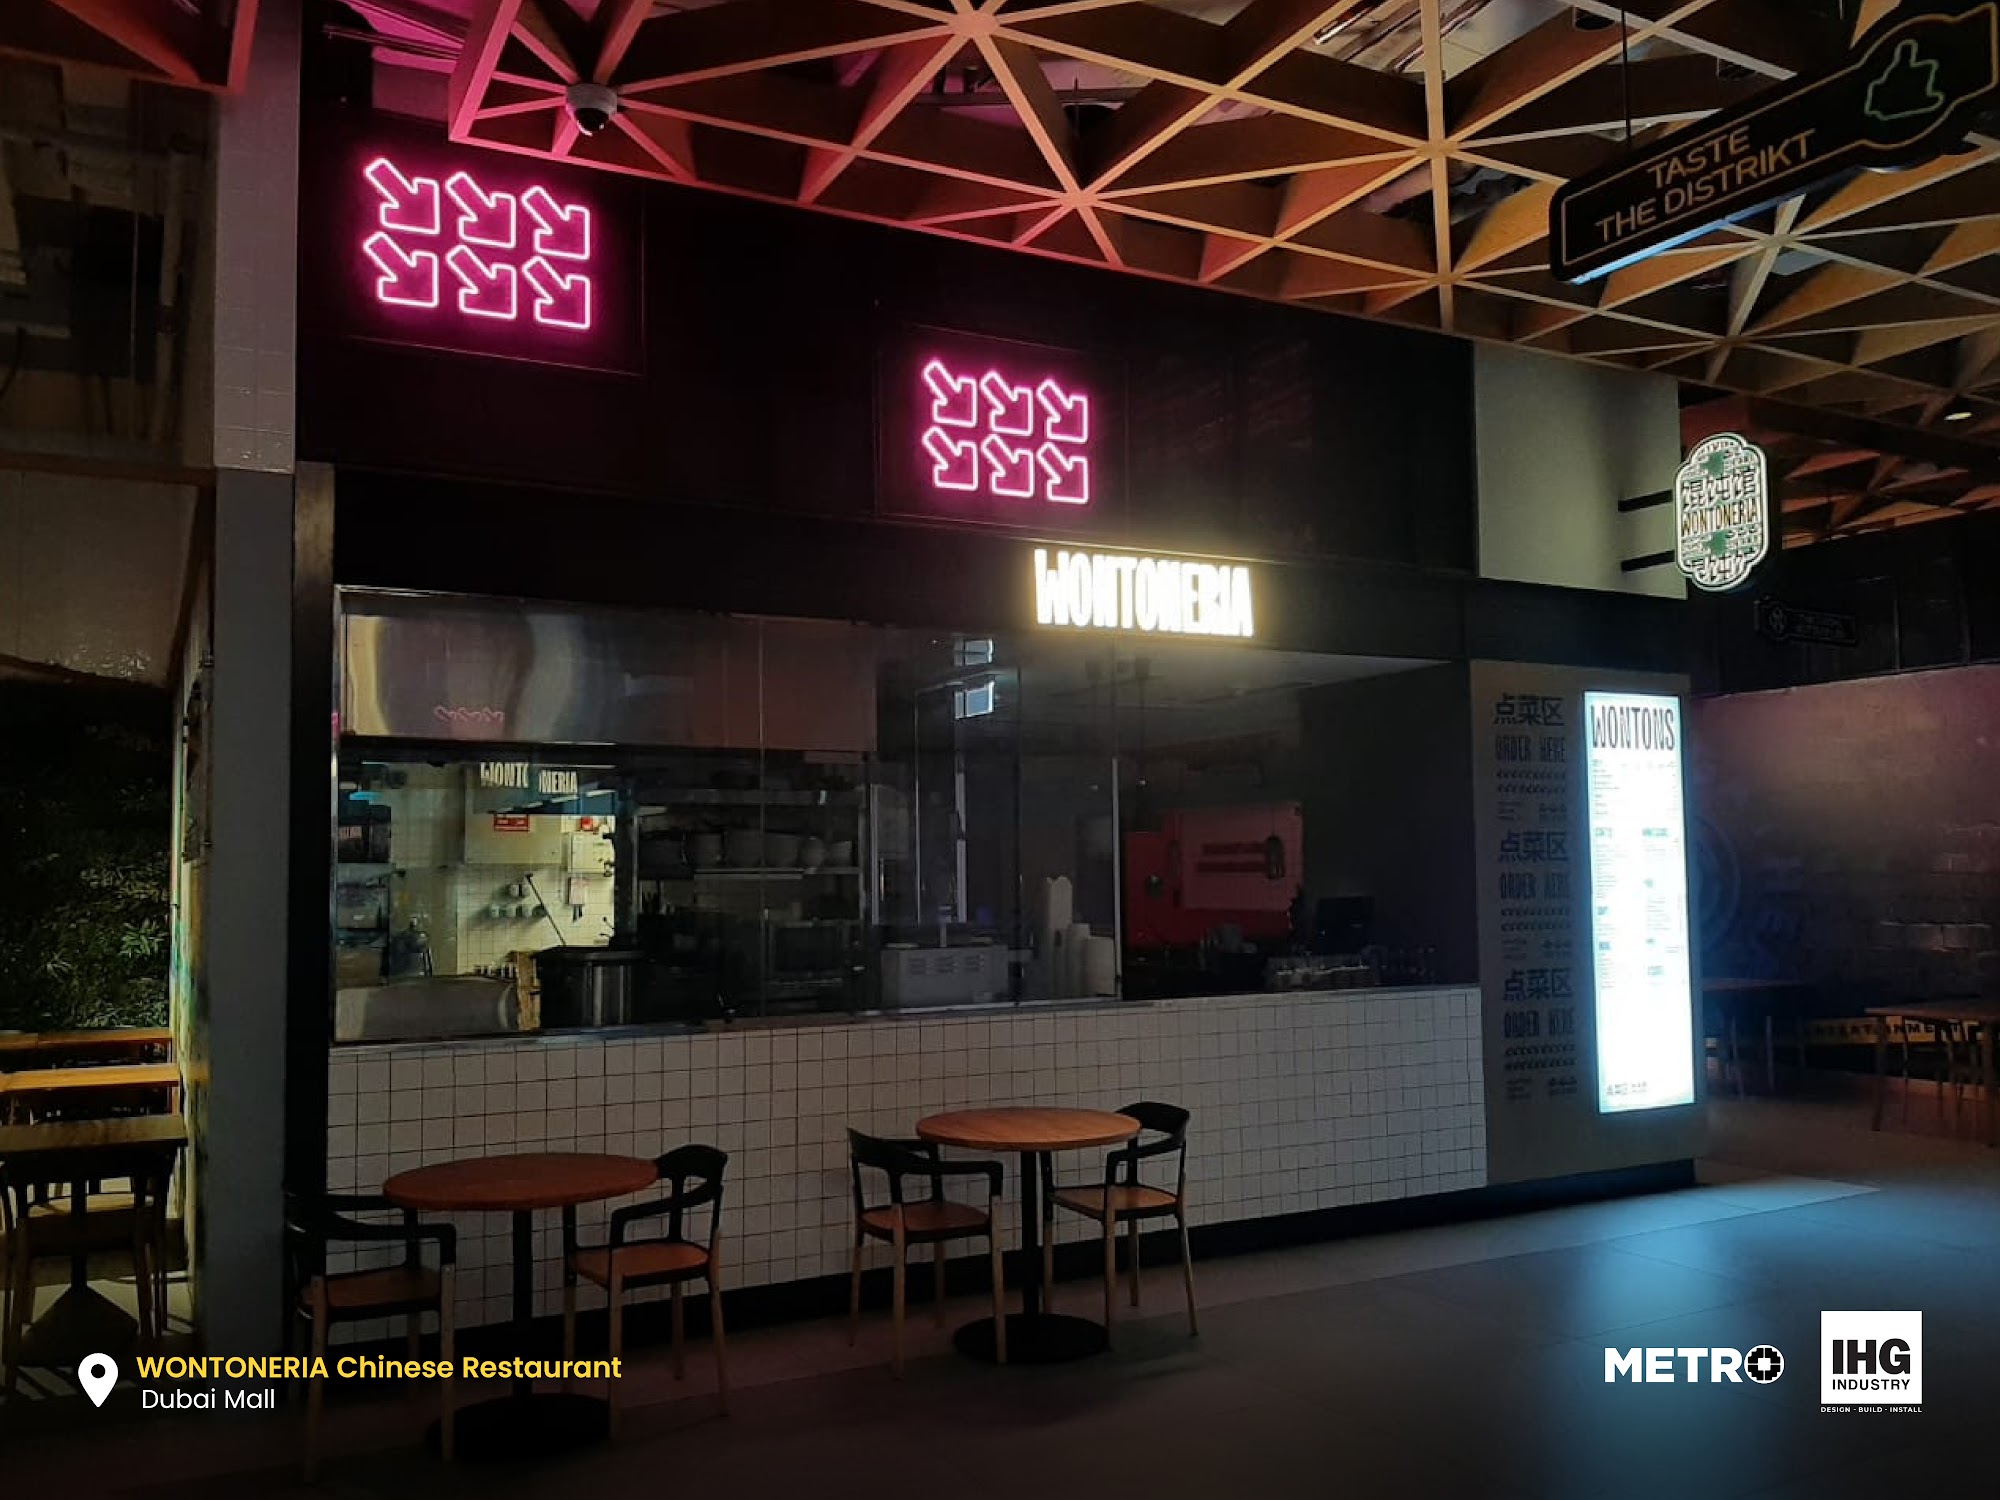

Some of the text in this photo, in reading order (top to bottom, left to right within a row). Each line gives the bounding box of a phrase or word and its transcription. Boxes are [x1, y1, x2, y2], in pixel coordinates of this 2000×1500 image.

[1595, 129, 1816, 242] THE DISTRIKT
[1646, 125, 1750, 189] TASTE
[1034, 547, 1255, 638] WONTONERIA
[1493, 693, 1565, 727] 点菜区
[1590, 704, 1675, 751] WONTONS
